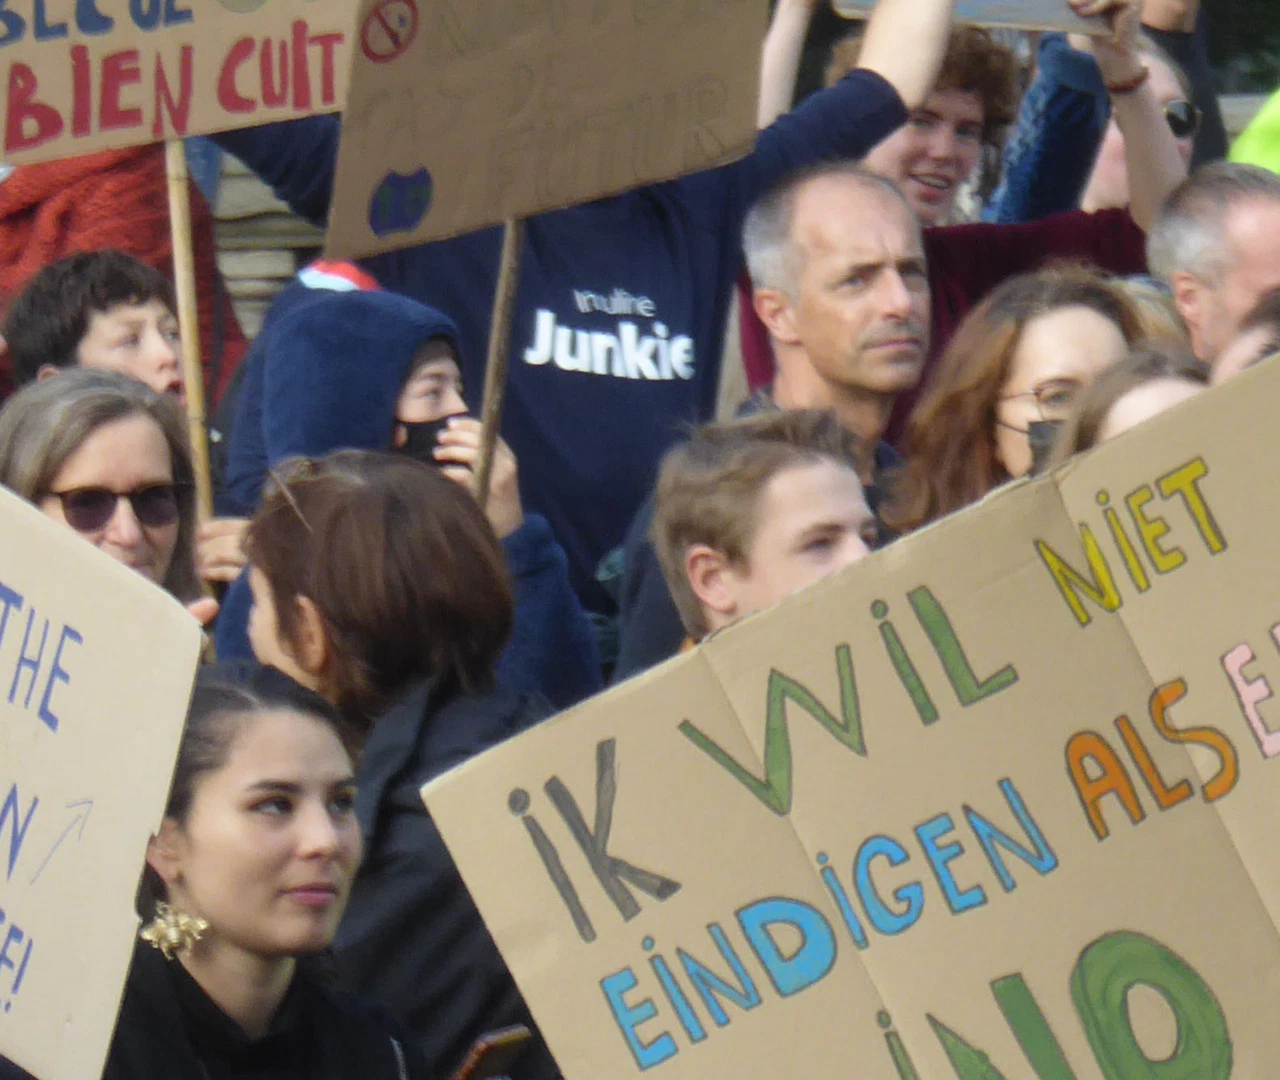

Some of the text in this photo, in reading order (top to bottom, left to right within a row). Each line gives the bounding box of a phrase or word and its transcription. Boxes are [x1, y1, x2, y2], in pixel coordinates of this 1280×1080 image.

[4, 19, 345, 154] BIEN CUIT
[523, 307, 697, 381] Junkie
[1062, 677, 1241, 841] ALS
